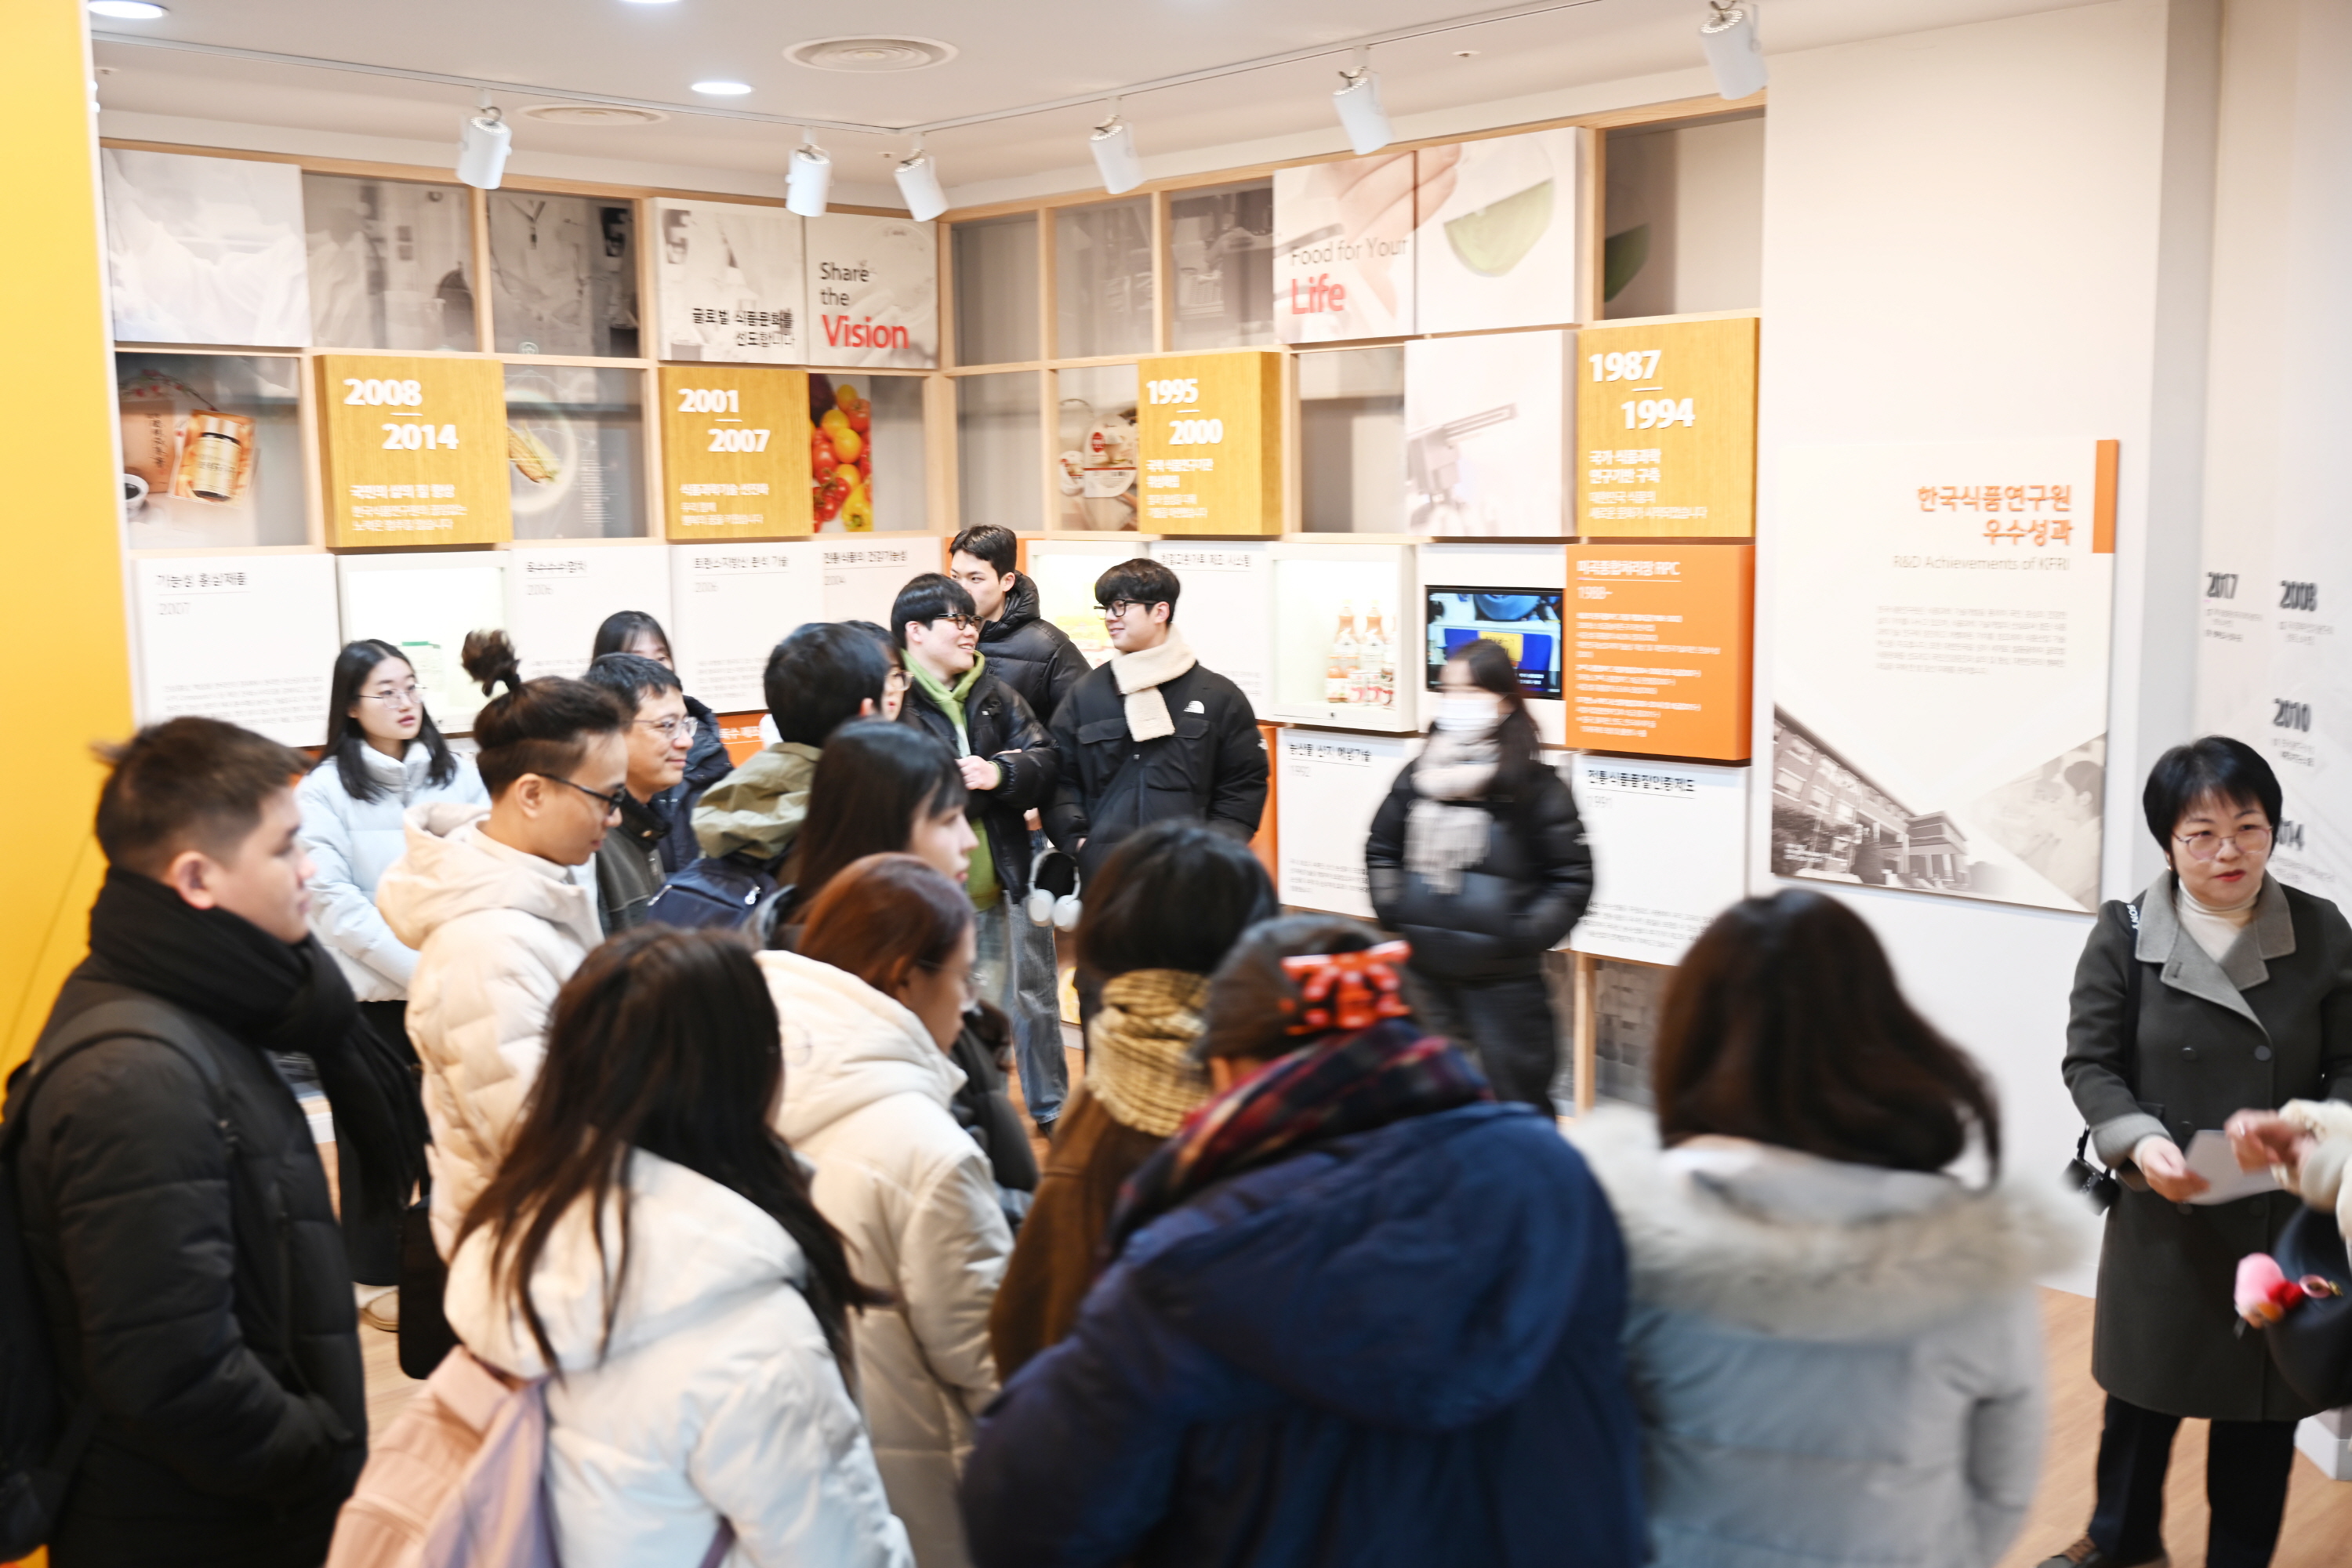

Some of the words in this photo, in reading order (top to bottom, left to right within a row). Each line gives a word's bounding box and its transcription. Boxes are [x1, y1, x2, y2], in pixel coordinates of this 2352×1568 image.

[1290, 240, 1334, 267] Food
[1338, 239, 1363, 262] for
[1366, 237, 1410, 259] Your
[819, 261, 869, 282] Share
[820, 287, 850, 306] the
[1291, 274, 1345, 315] Life
[692, 308, 729, 325] 글로벌
[820, 314, 910, 350] Vision
[1589, 350, 1661, 383] 1987
[343, 378, 423, 406] 2008
[678, 389, 739, 413] 2001
[1146, 378, 1199, 405] 1995
[1621, 397, 1696, 430] 1994
[381, 423, 460, 450] 2014
[707, 429, 771, 453] 2007
[1168, 419, 1223, 445] 2000
[1918, 485, 2072, 513] 한국식품연구원
[1983, 519, 2074, 546] 우수성과
[1893, 555, 1921, 569] R&D
[1925, 555, 2018, 570] Achievements
[2023, 557, 2037, 570] of
[2273, 698, 2311, 732] 2010
